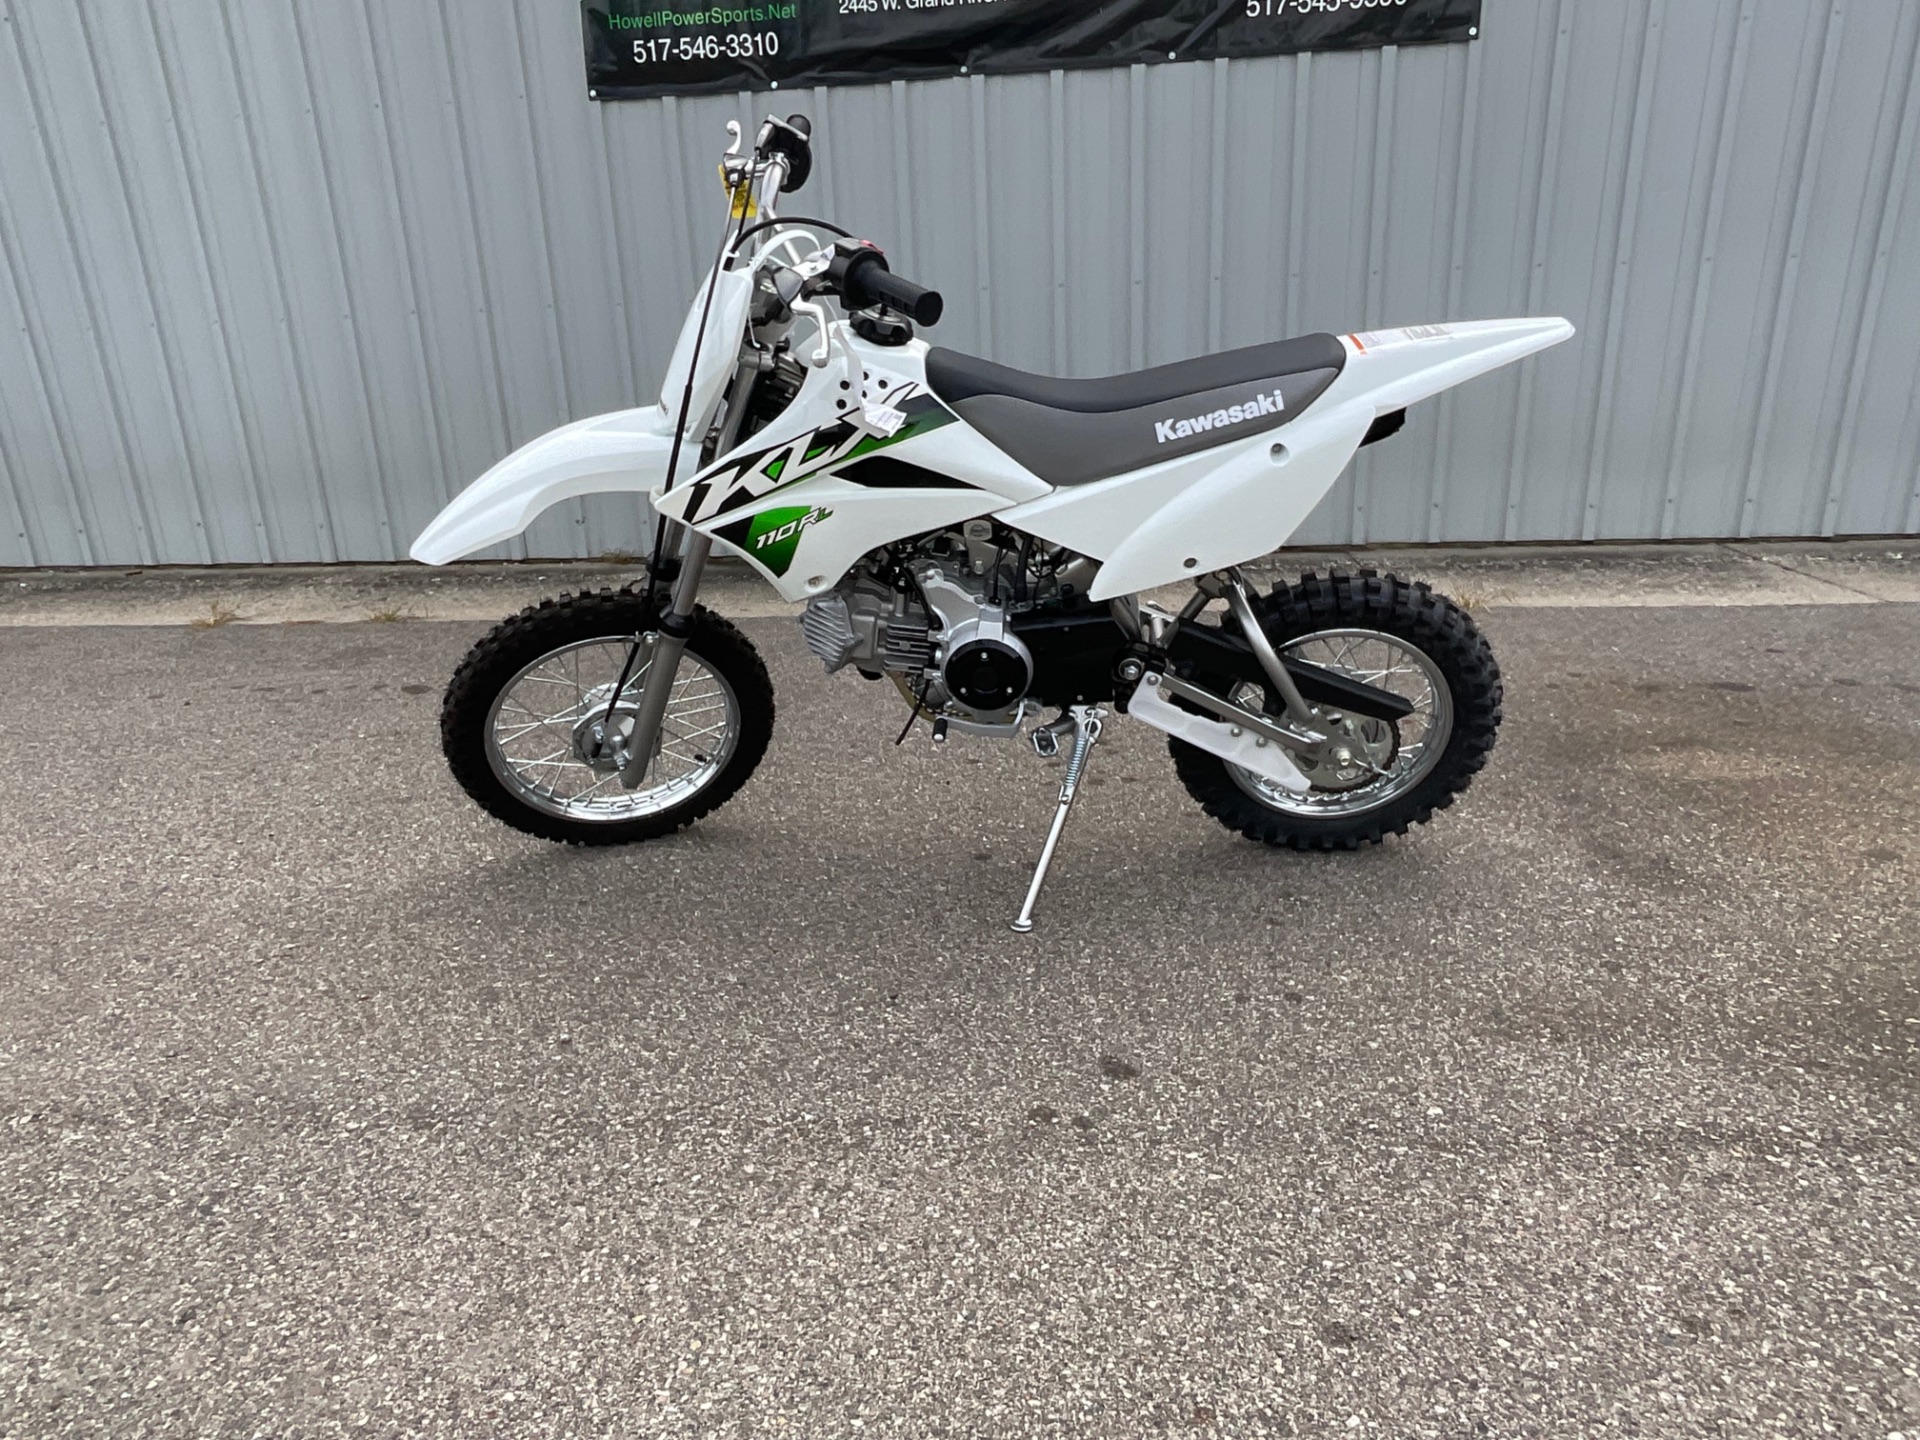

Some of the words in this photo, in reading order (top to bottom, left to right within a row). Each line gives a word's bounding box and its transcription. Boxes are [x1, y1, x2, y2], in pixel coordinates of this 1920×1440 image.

[608, 4, 796, 29] HowellPowerSports.Net
[838, 0, 878, 14] 2445
[633, 31, 779, 64] 517-546-3310
[1154, 389, 1285, 444] Kawasaki
